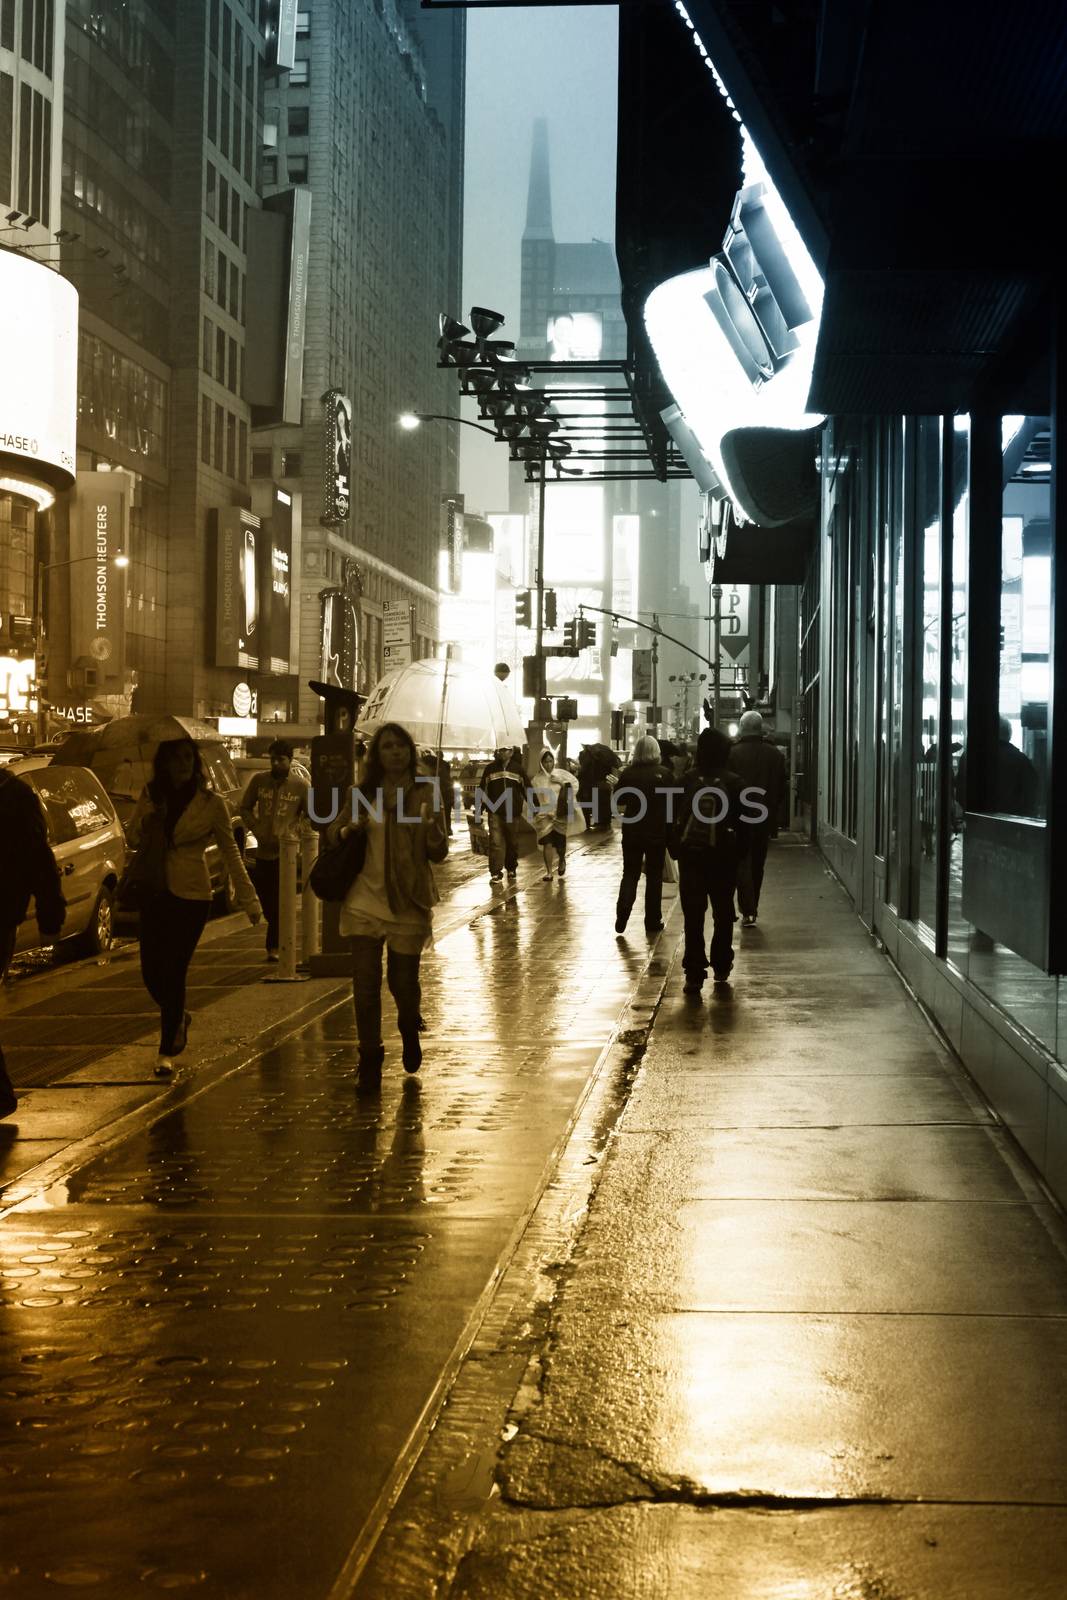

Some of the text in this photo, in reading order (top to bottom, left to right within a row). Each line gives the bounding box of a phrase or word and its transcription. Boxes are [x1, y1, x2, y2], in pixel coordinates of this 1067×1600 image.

[293, 254, 304, 337] THOMSON REUTERS
[96, 505, 107, 630] THOMSON REUTERS
[223, 528, 233, 621] THOMSON REUTERS
[384, 602, 389, 611] 3
[384, 648, 390, 656] 6
